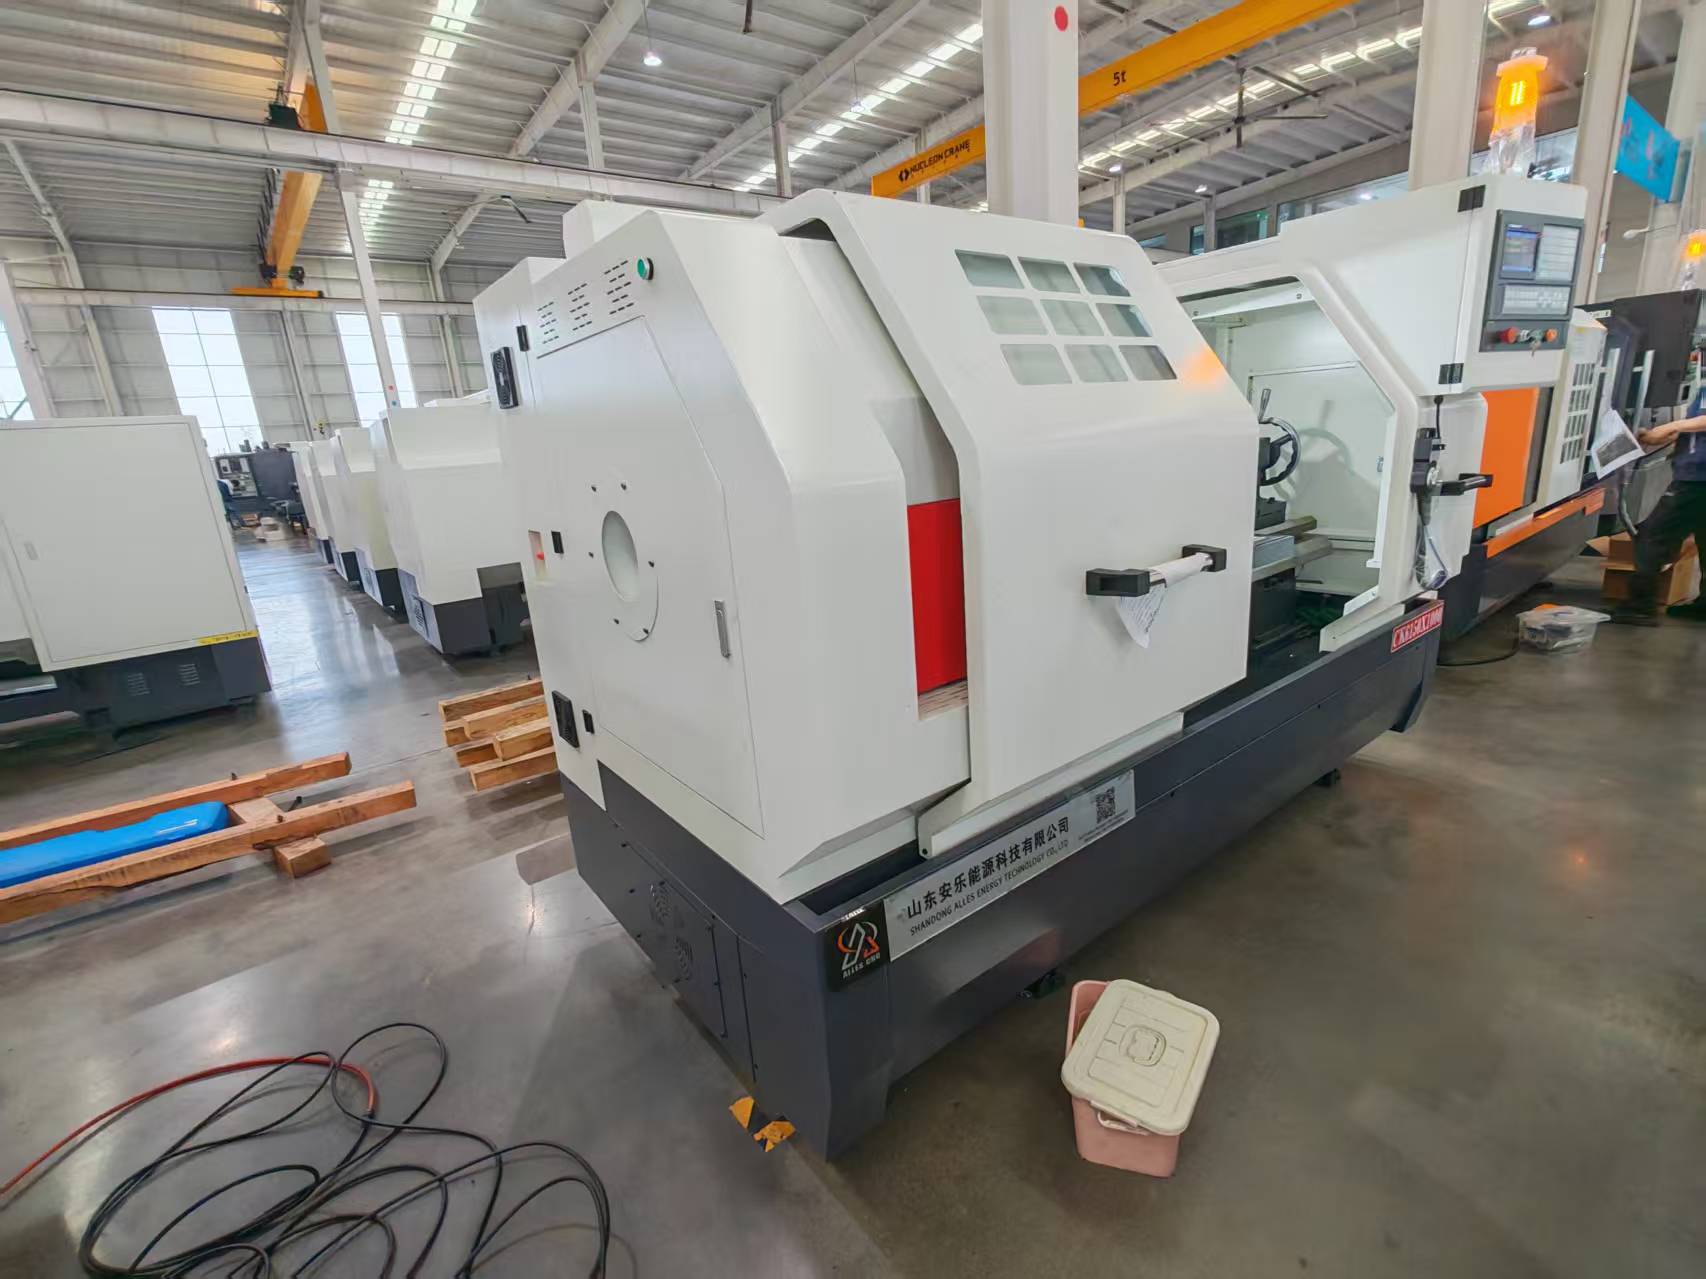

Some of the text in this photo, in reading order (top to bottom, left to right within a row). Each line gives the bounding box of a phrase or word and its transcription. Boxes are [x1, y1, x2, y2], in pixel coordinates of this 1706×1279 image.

[944, 140, 971, 159] CRANE
[907, 816, 1069, 919] 山东安乐能源科技有限公司
[910, 905, 953, 936] SHANDONG
[954, 892, 976, 911] ALLES
[977, 877, 1003, 898] ENERGY
[1004, 853, 1045, 881] TECHNOLOGY
